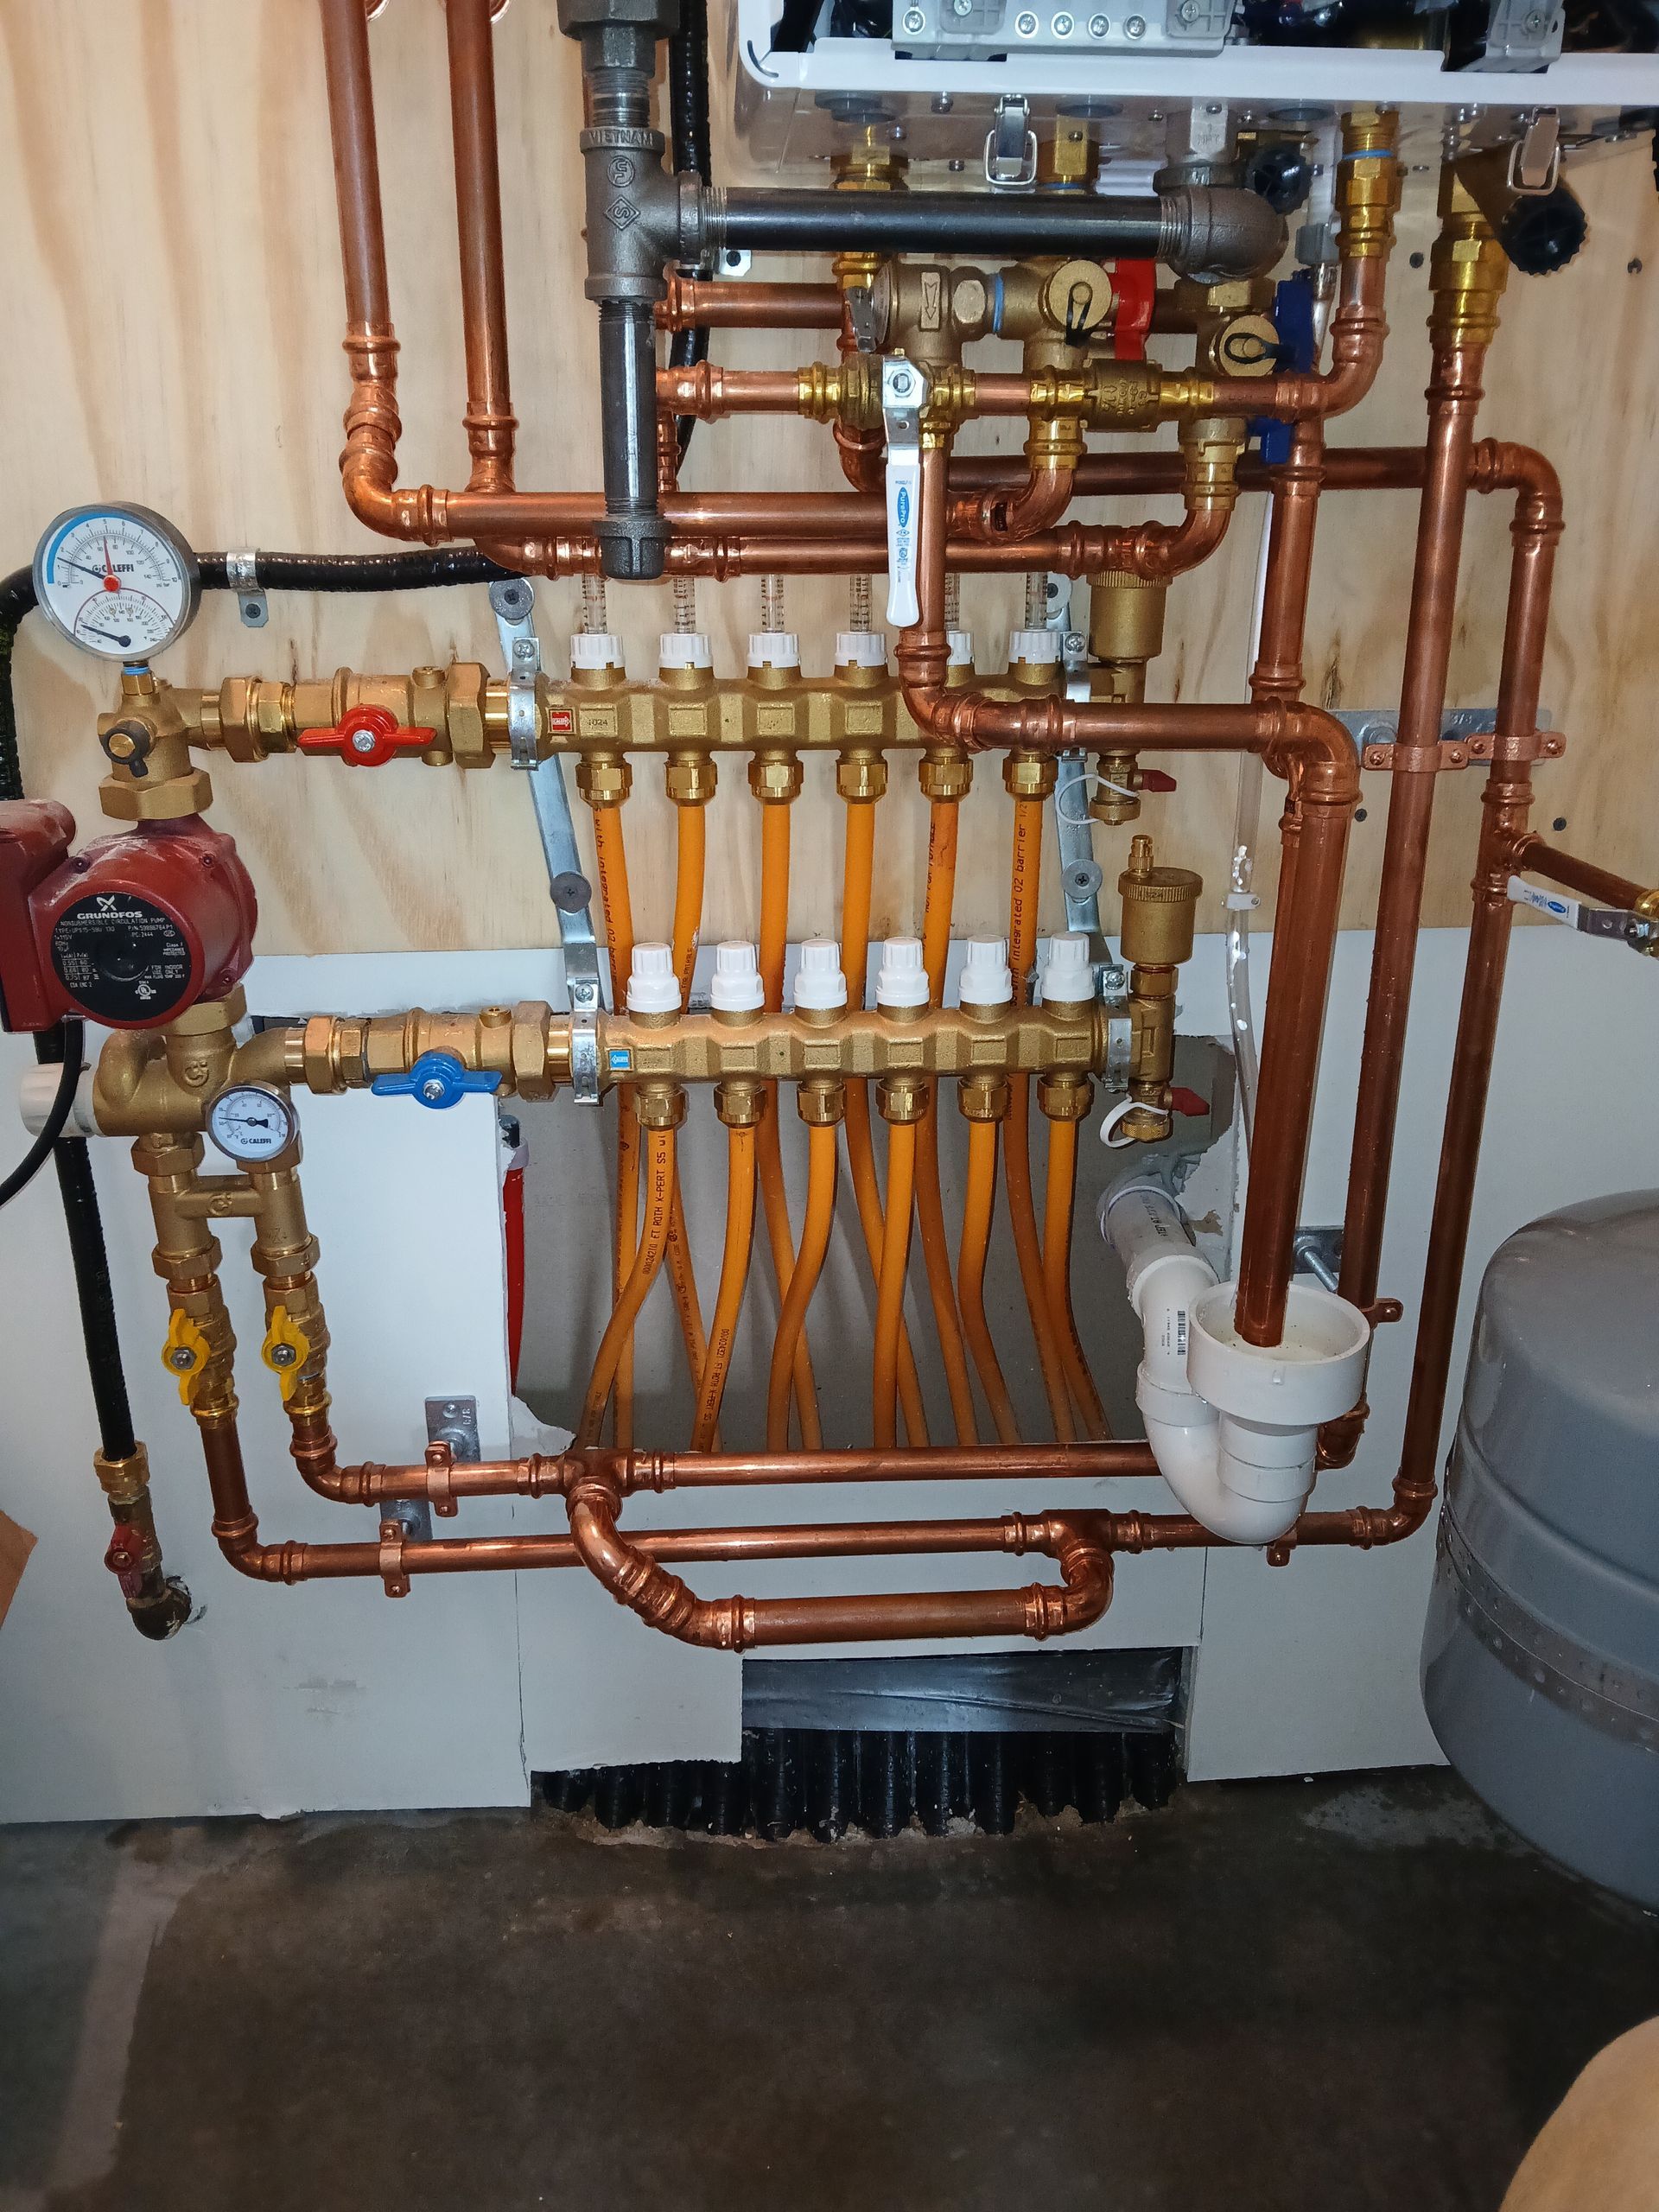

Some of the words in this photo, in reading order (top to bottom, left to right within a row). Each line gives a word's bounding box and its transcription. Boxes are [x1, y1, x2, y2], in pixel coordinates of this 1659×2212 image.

[589, 130, 653, 146] VIETNAM
[102, 564, 134, 573] CLEFFI
[1015, 824, 1026, 873] barrier
[599, 857, 613, 923] integrated
[77, 911, 143, 919] GRUNDFOS
[1012, 899, 1022, 961] integrated
[657, 1152, 666, 1164] S5
[655, 1170, 665, 1203] X-PERT
[653, 1206, 663, 1226] ROTH
[710, 1372, 721, 1388] ROTH
[705, 1389, 717, 1410] X-PERT
